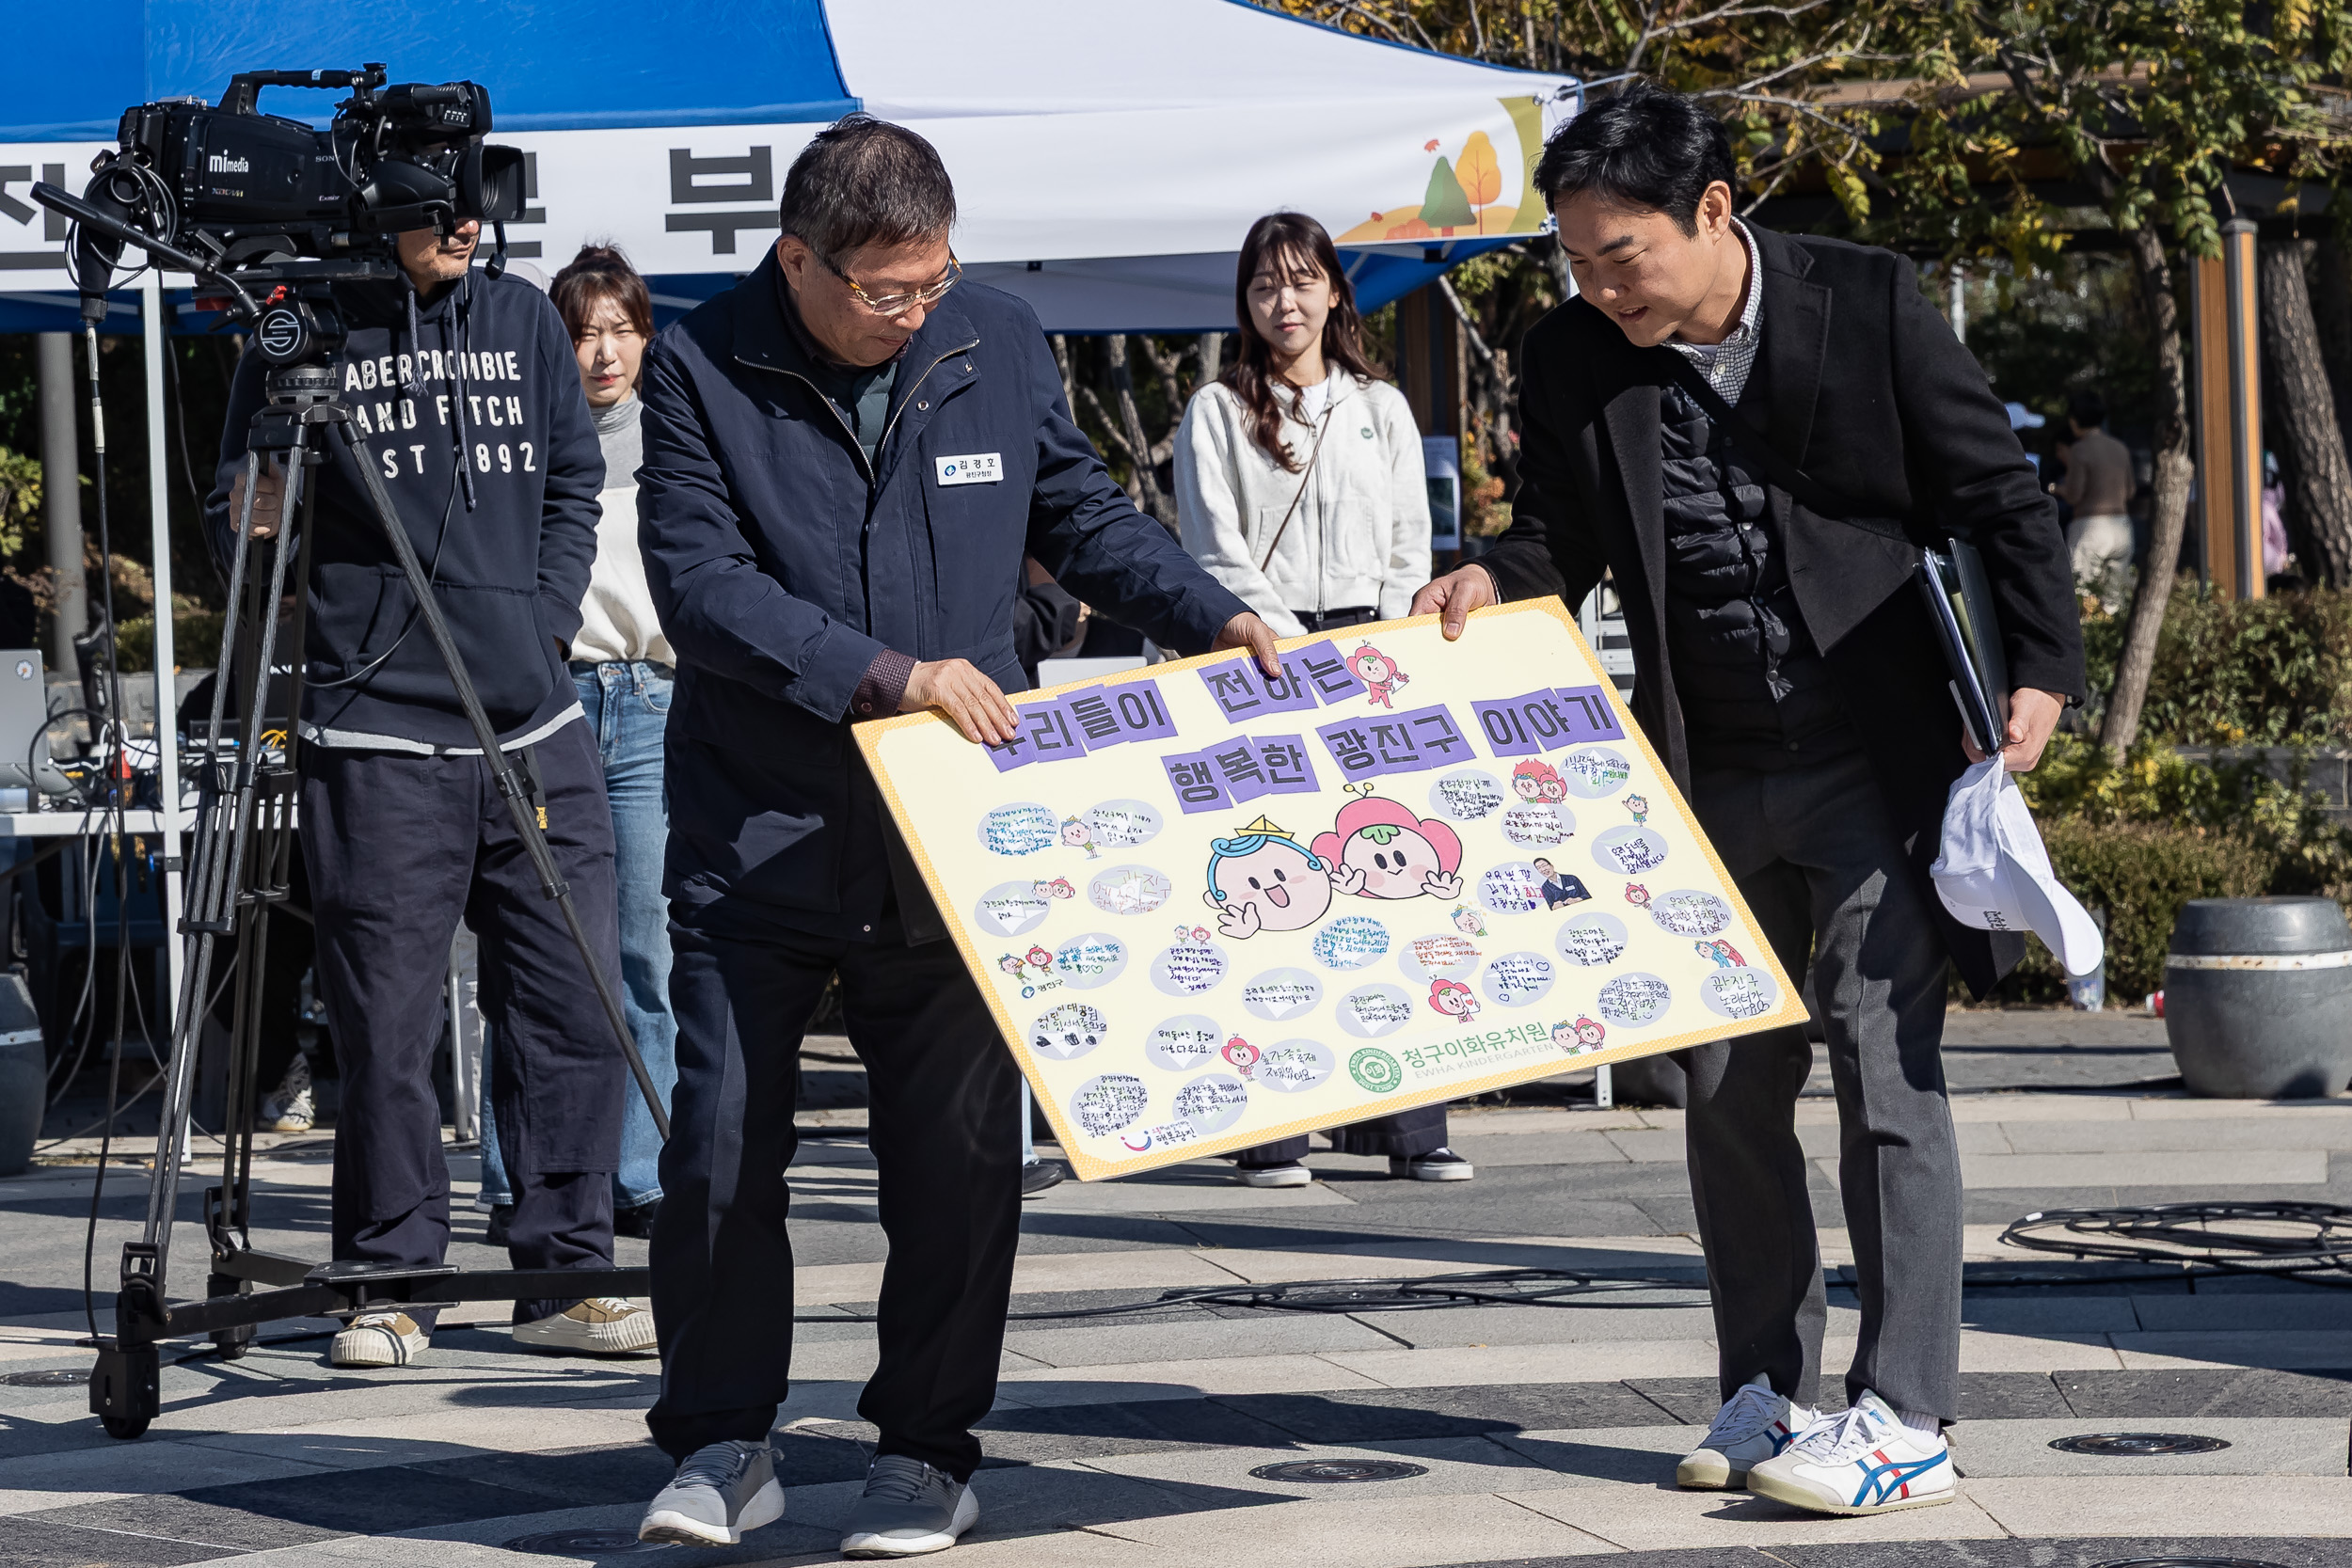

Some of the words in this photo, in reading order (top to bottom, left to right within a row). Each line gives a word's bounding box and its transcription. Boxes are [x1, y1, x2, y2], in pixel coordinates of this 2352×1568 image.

[357, 399, 417, 434] AND
[436, 395, 523, 426] FTCH
[960, 457, 995, 469] 김경호
[965, 470, 992, 479] 광진구청장
[1169, 743, 1307, 803] 행복한
[1326, 714, 1459, 770] 광진구
[1481, 694, 1613, 745] 이야기
[1038, 979, 1063, 991] 광진구
[1402, 1022, 1549, 1069] 청구이화유치원
[1414, 1065, 1455, 1079] EWHA
[1457, 1042, 1554, 1069] KINDERGARTEN
